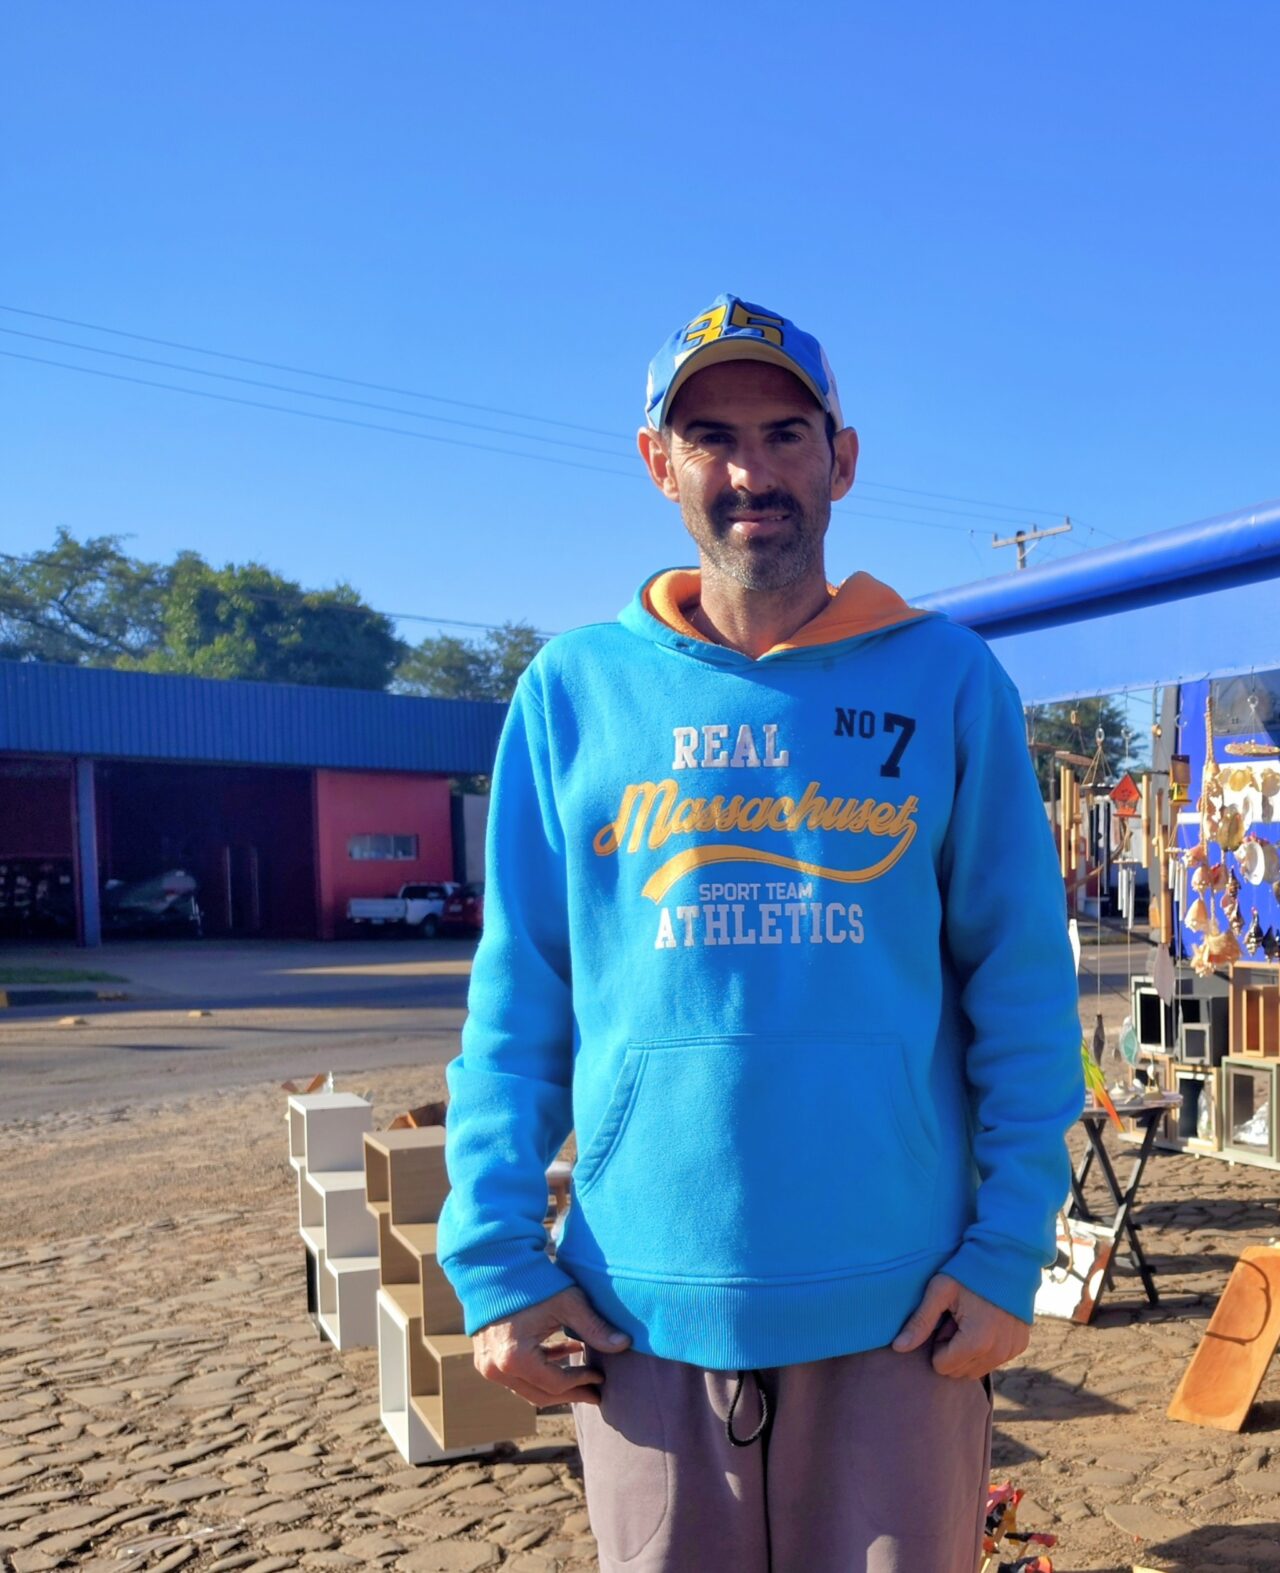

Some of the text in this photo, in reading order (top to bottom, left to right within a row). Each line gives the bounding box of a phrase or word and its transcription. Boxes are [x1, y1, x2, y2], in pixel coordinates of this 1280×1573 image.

[683, 302, 784, 350] 35
[672, 723, 789, 770] REAL
[834, 707, 917, 779] NO 7
[593, 779, 919, 856] Massachuset
[699, 881, 813, 901] SPORT TEAM
[654, 902, 865, 950] ATHLETICS
